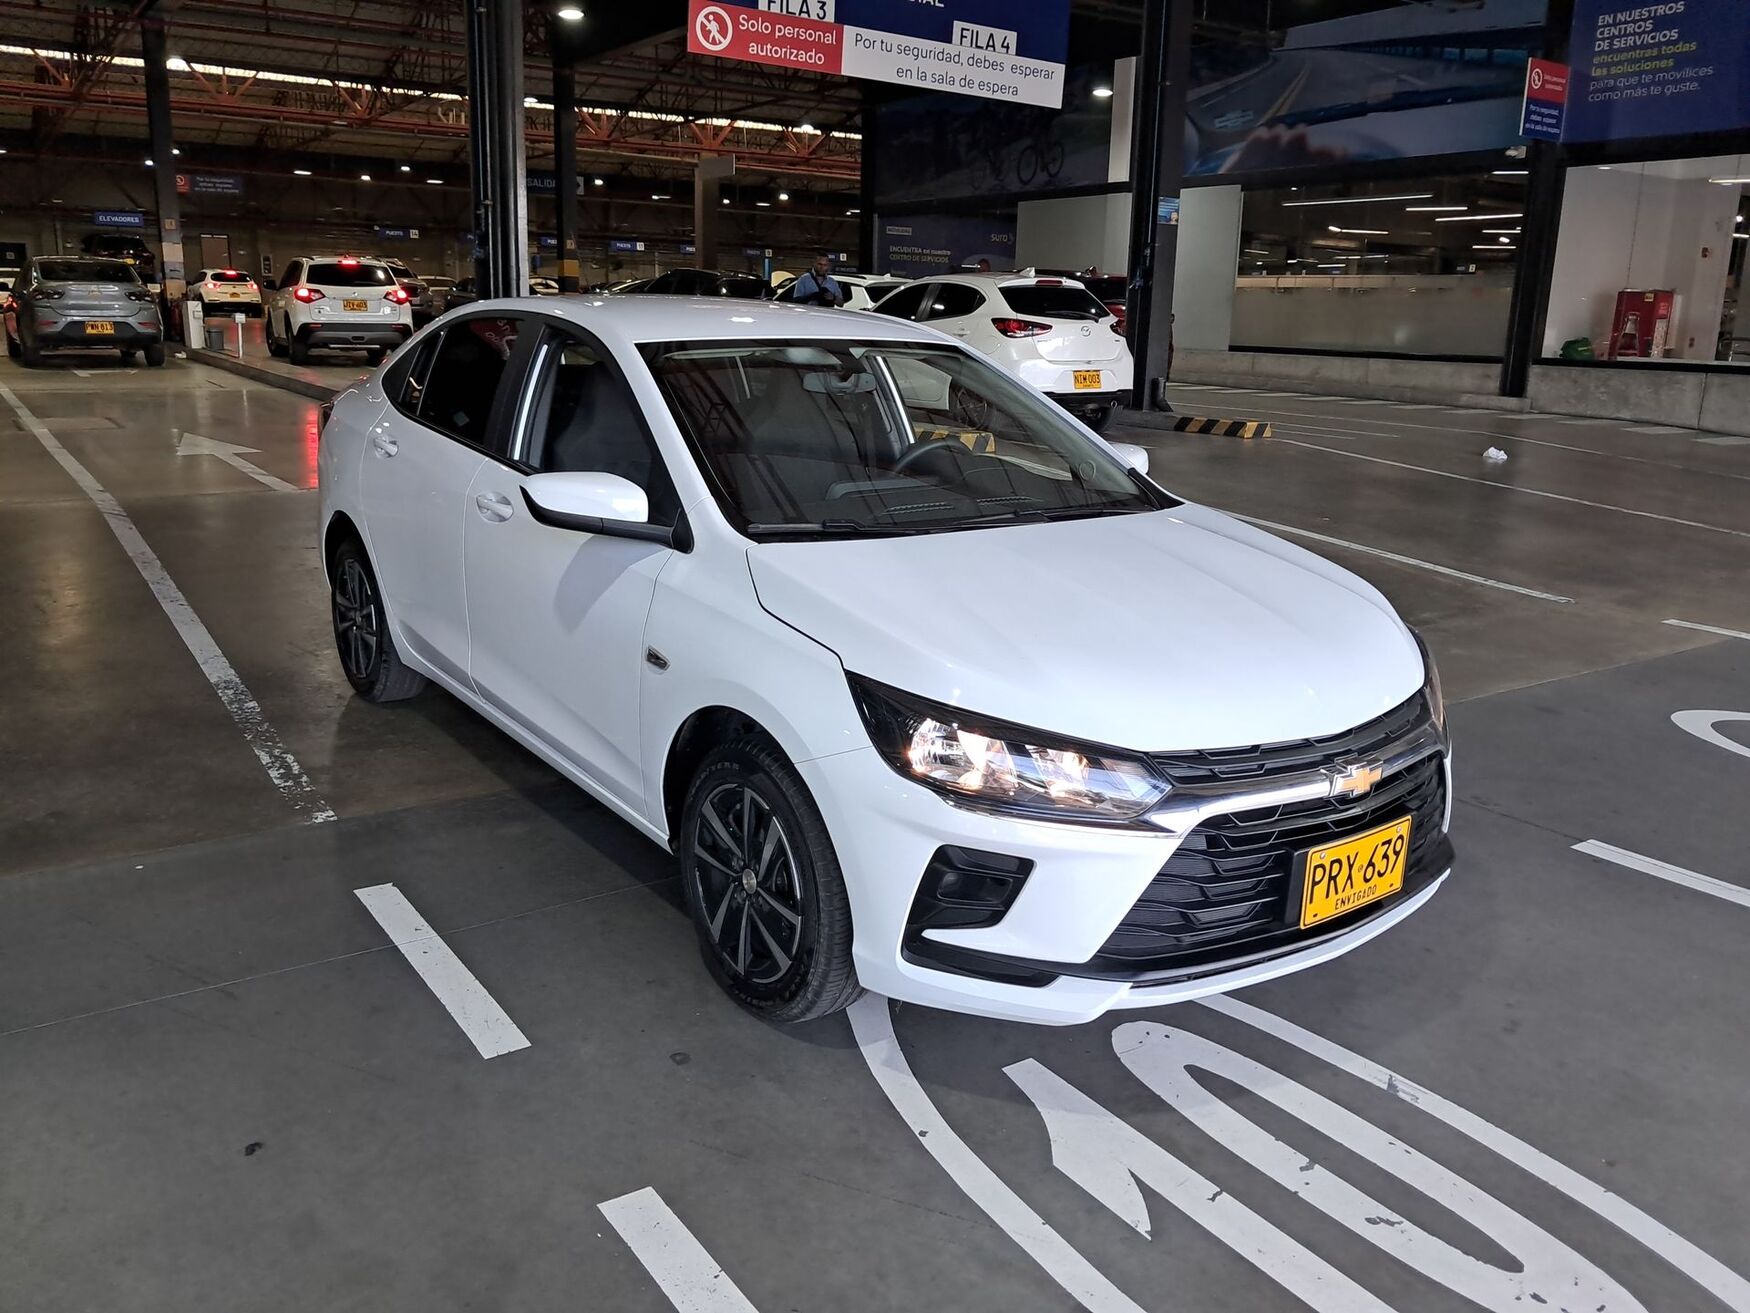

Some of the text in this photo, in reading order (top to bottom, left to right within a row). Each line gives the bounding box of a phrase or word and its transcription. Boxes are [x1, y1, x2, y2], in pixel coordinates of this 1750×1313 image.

[816, 0, 827, 20] 3
[1597, 1, 1685, 26] EN NUESTROS
[739, 14, 837, 45] Solo personal
[960, 27, 1010, 54] FILA 4
[1594, 29, 1679, 51] DE SERVICIOS
[1596, 20, 1654, 38] CENTROS
[749, 42, 825, 65] autorizado
[855, 33, 1055, 81] Por tu seguridad, debes esperar
[1593, 42, 1697, 64] encuentras todas
[1590, 65, 1714, 91] para que te movilices
[1591, 58, 1675, 77] las soluciones
[896, 66, 1018, 97] en la sala de espera
[1588, 90, 1620, 102] como
[1650, 85, 1662, 95] te
[99, 215, 140, 223] ELEVADORES
[1074, 373, 1101, 384] NIM 003
[1309, 834, 1405, 904] PRX 639
[1335, 885, 1377, 910] ENVIGADO
